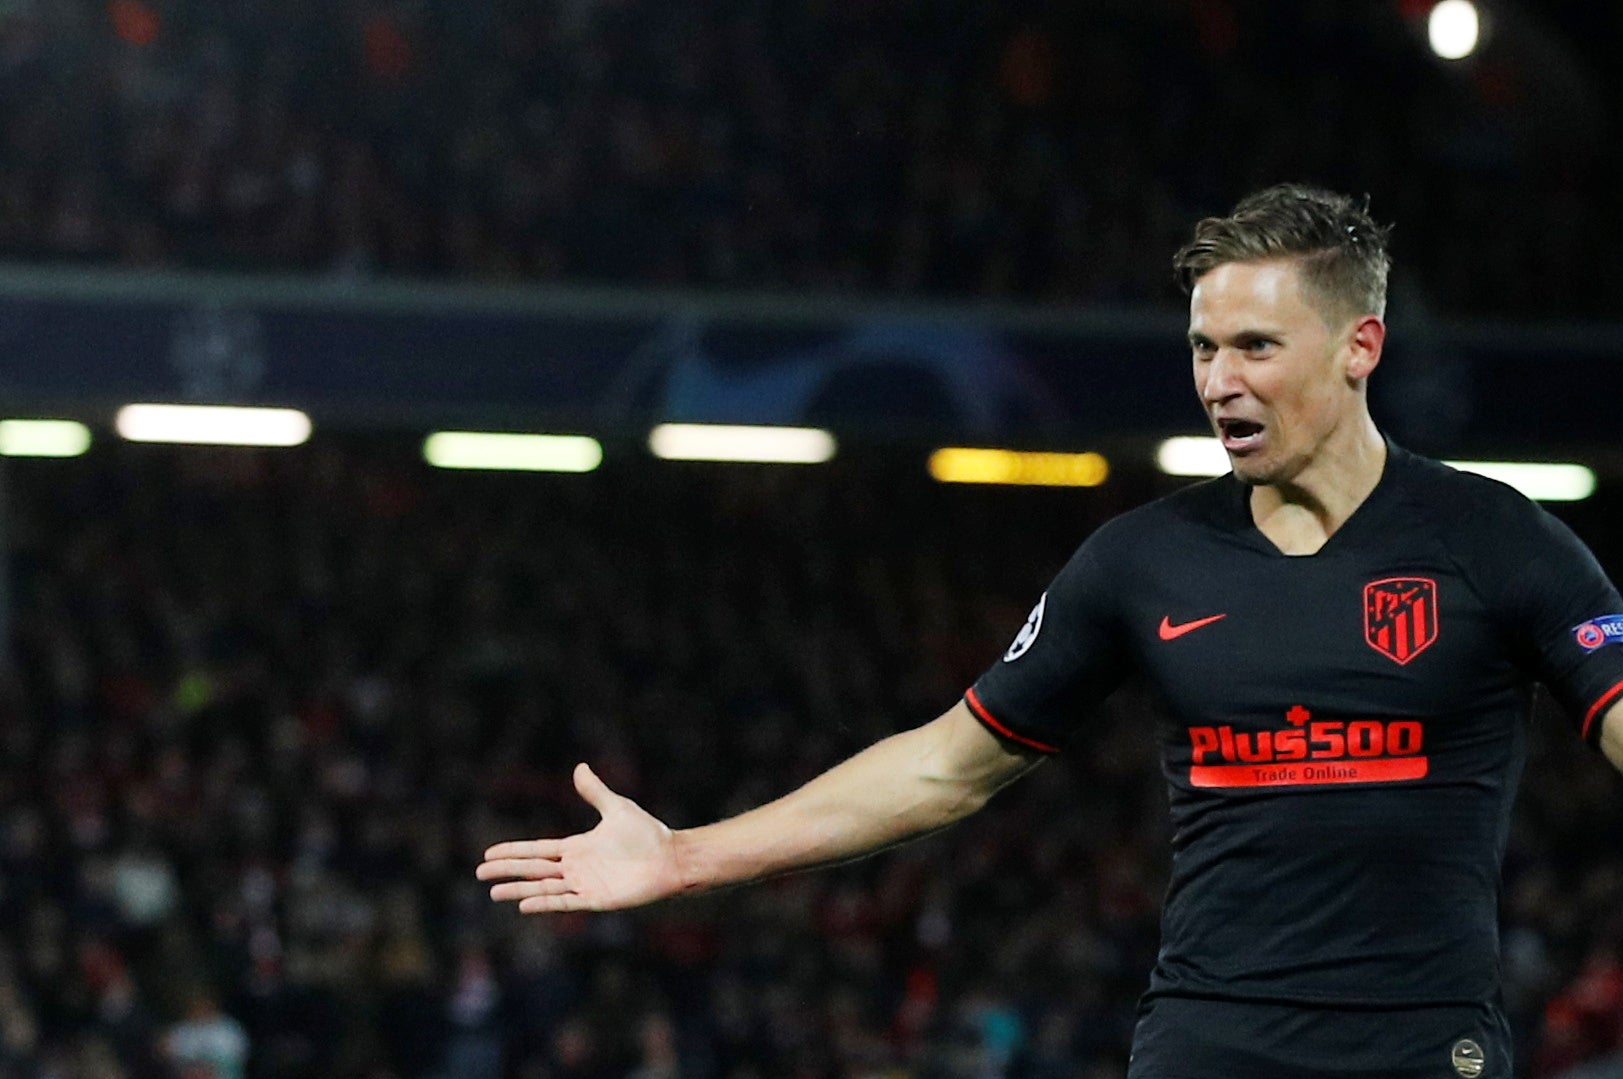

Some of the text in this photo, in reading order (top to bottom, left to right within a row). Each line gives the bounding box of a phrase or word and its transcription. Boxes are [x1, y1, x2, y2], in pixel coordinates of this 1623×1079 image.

[1188, 720, 1423, 765] Plus500
[1252, 764, 1358, 783] Trade Online
